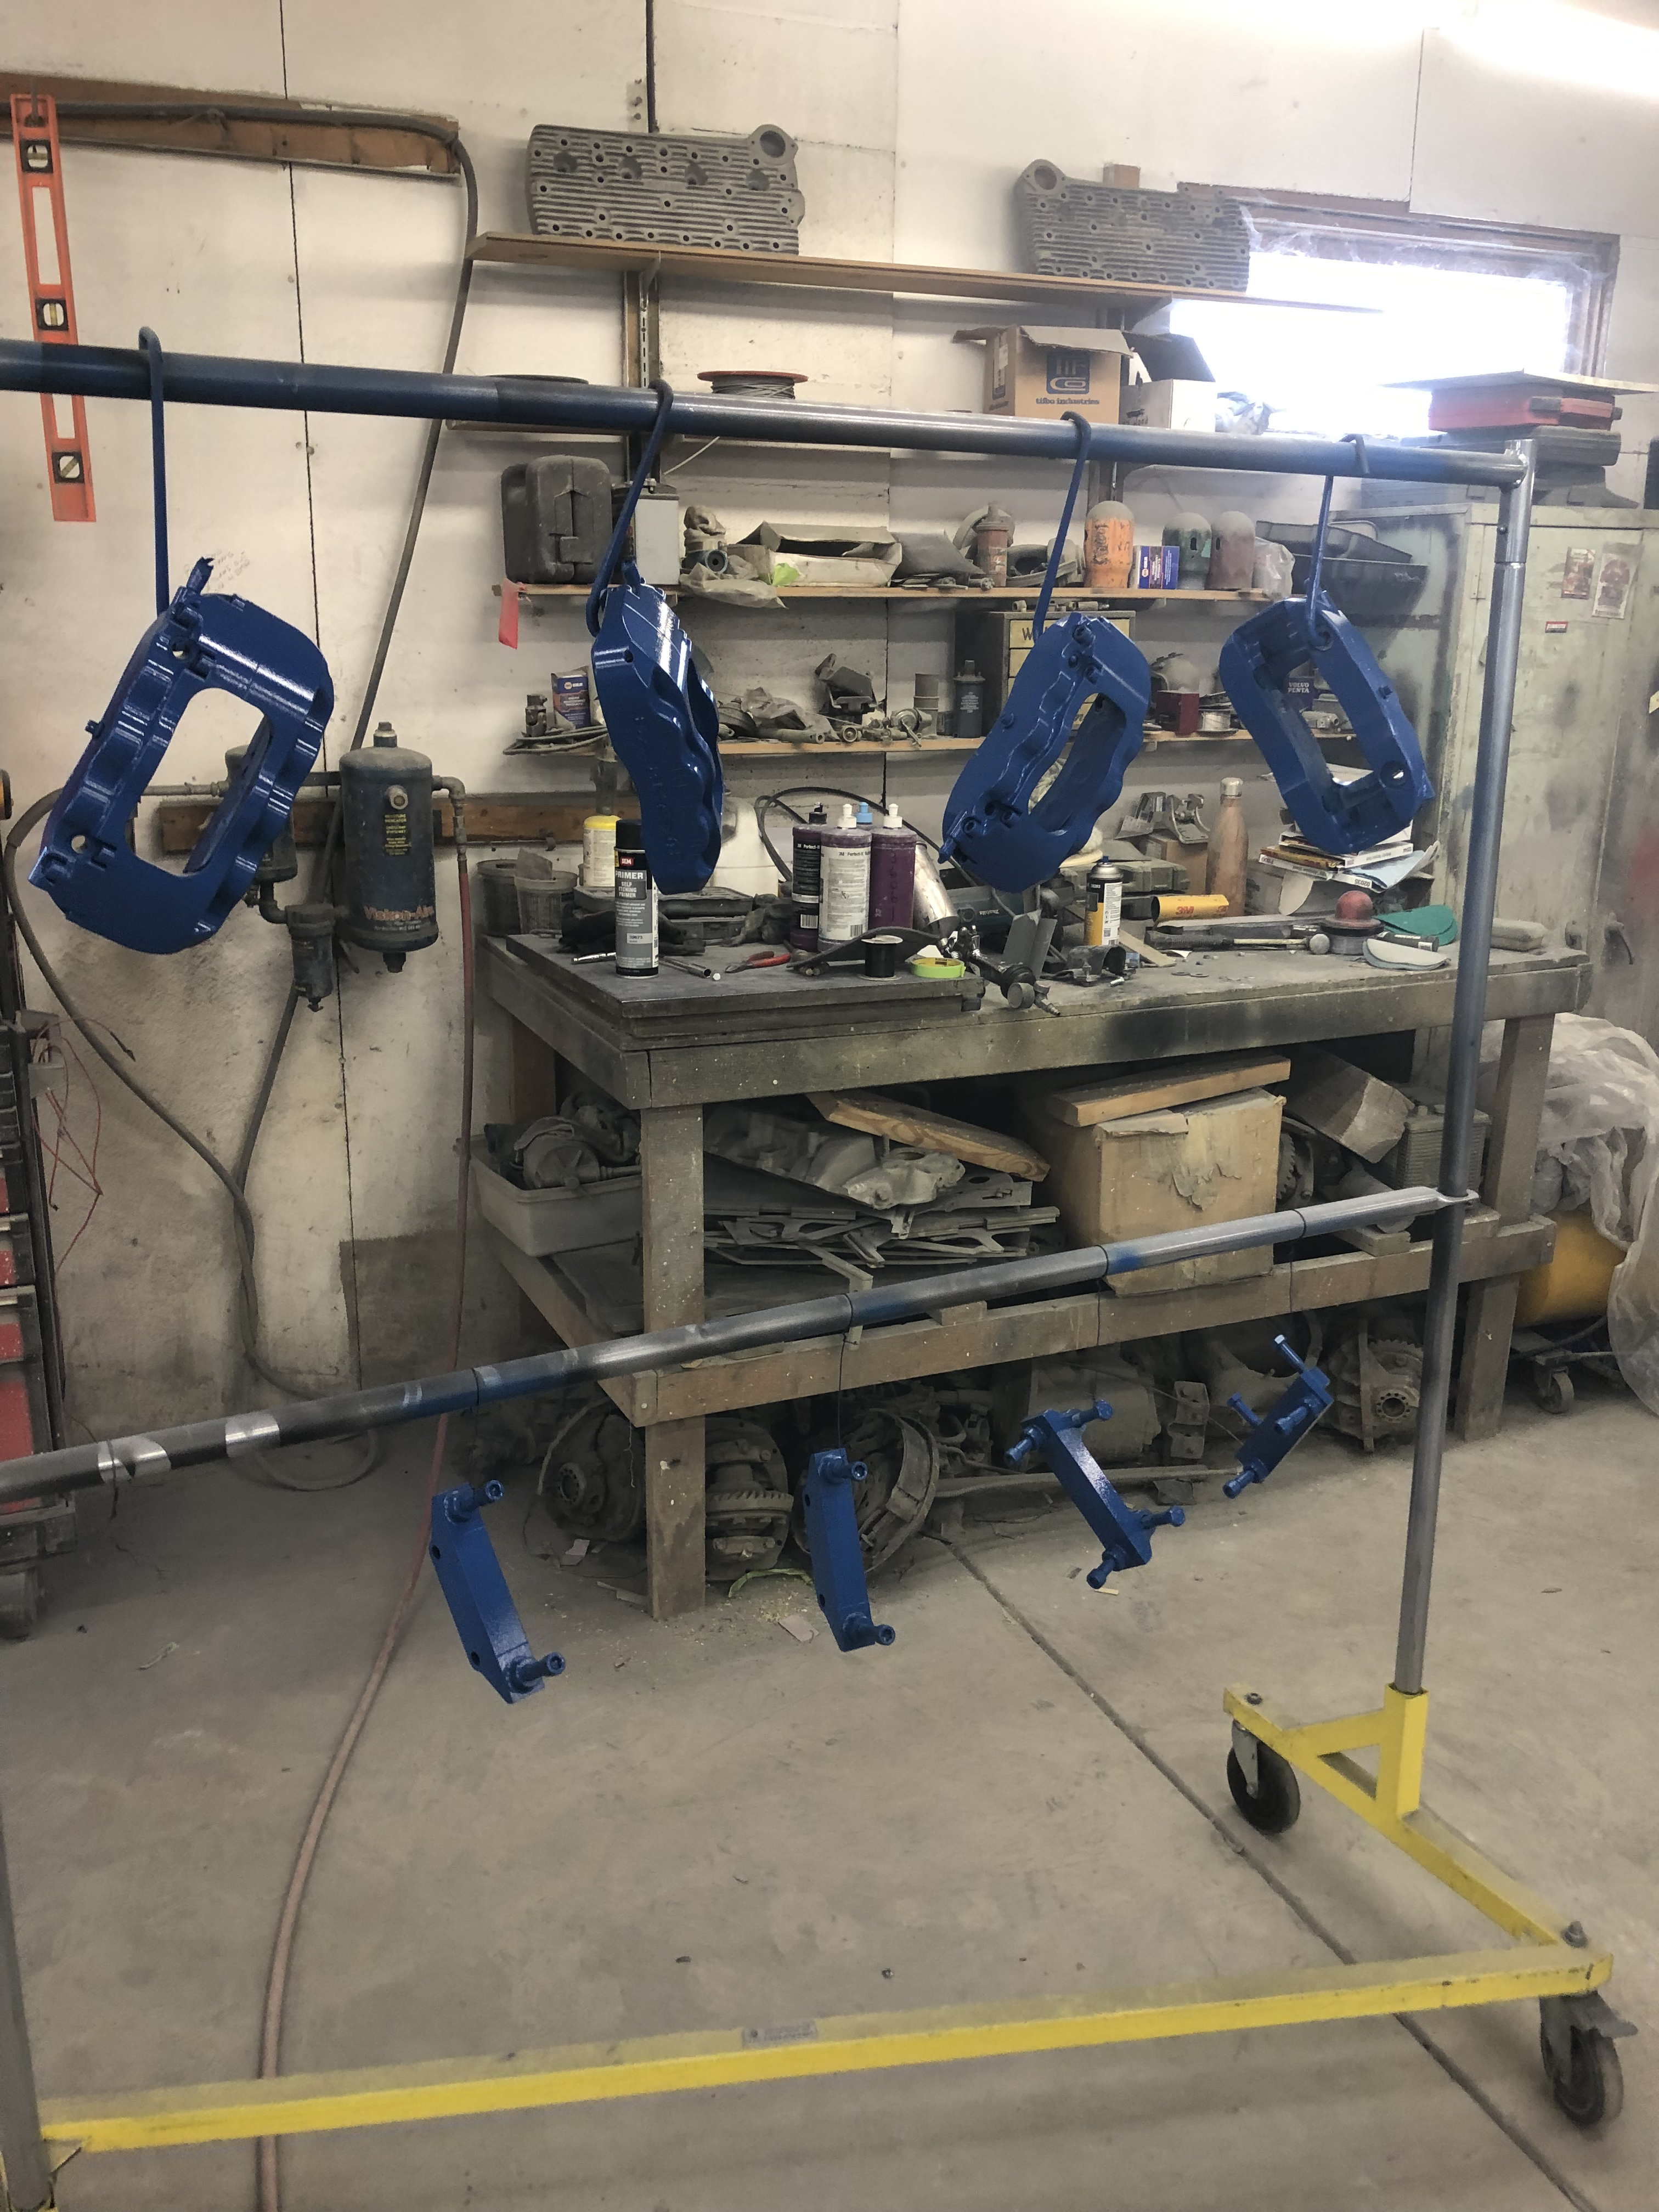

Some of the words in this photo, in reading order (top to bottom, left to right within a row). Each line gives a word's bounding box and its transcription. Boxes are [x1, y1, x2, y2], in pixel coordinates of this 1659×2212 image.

[615, 870, 644, 879] PRIMER
[1355, 878, 1370, 887] 02035
[1175, 906, 1194, 915] 3M
